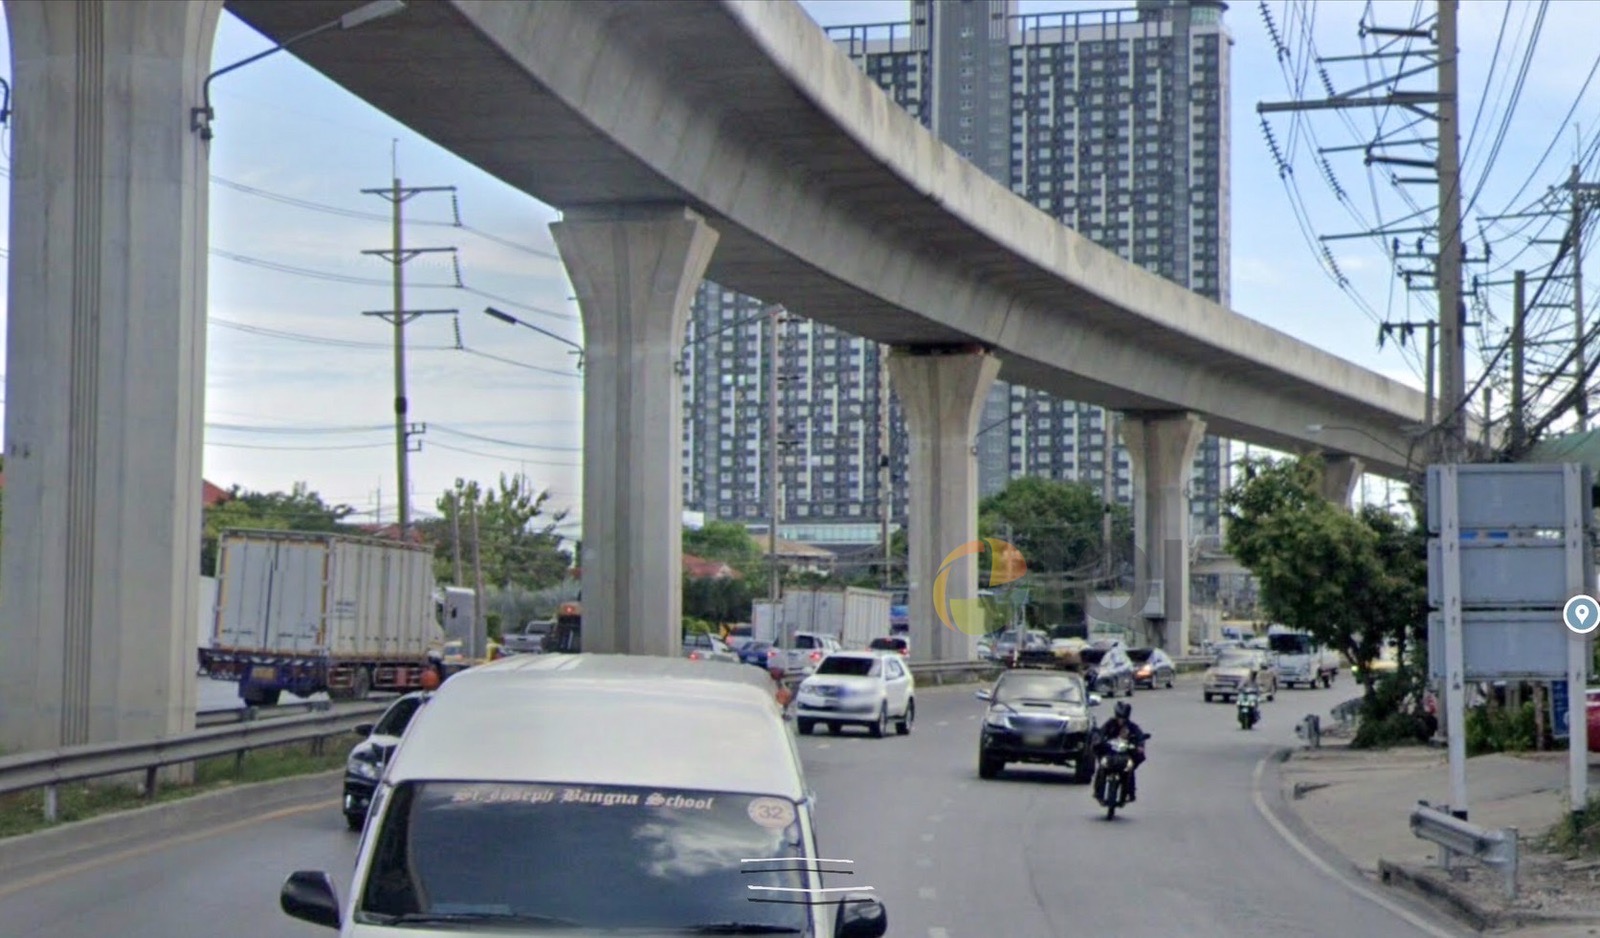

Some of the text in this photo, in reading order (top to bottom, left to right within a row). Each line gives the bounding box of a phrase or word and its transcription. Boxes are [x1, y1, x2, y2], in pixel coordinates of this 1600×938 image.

[485, 788, 554, 805] Joseph
[560, 788, 639, 806] Bangna
[645, 792, 714, 810] School
[760, 805, 783, 820] 32
